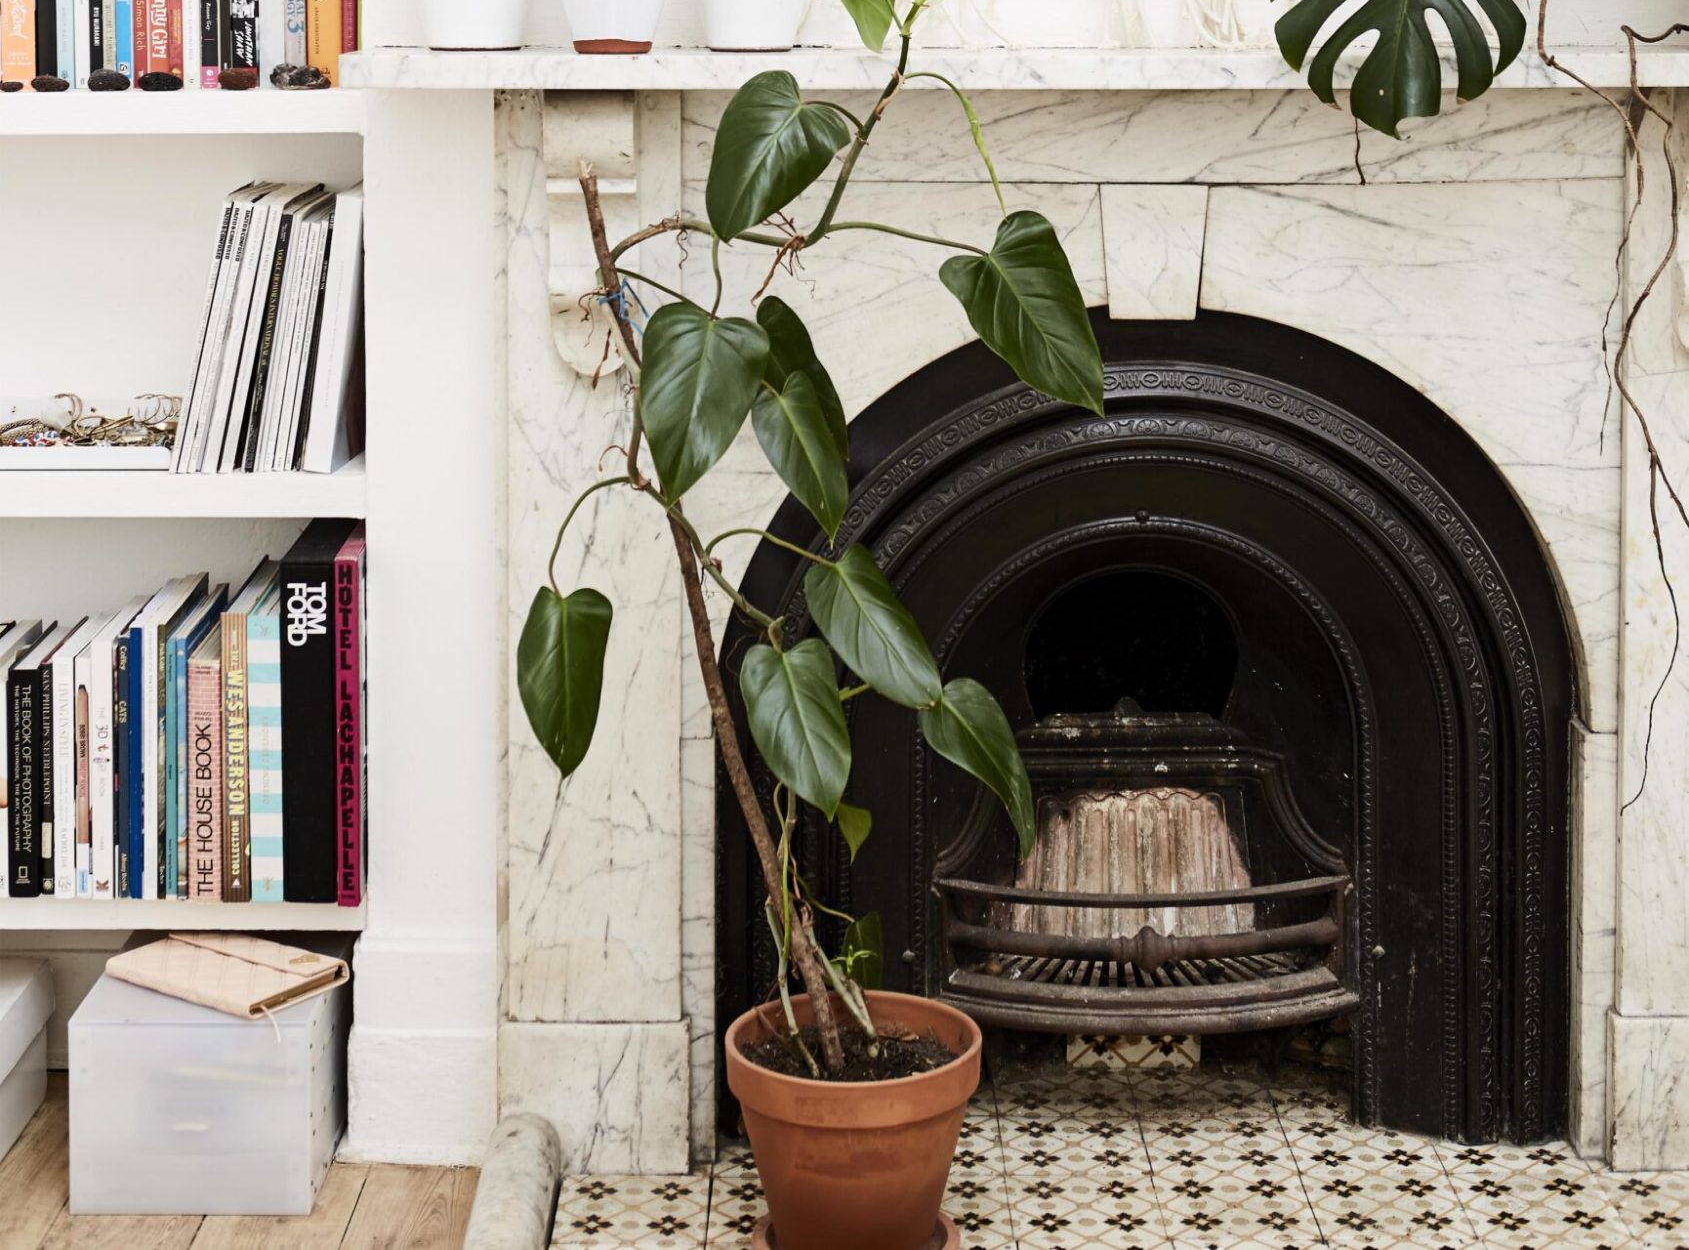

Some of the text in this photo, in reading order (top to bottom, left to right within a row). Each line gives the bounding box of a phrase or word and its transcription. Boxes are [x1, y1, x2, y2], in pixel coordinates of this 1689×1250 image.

[136, 0, 145, 51] Simon Rich
[152, 29, 168, 59] Girl
[234, 30, 245, 58] SHAW
[243, 20, 253, 67] JONATHAN
[287, 19, 305, 34] 3
[286, 582, 308, 647] FORD
[305, 581, 327, 634] TOM
[42, 669, 52, 806] SIAN PHILLIPS NEEDLEPOINT
[95, 724, 109, 739] 3D
[118, 700, 127, 723] CATS
[337, 563, 356, 893] HOTEL LACHAPELLE
[21, 684, 33, 853] THE BOOK OF PHOTOGRAPHY
[195, 723, 212, 780] BOOK
[226, 669, 245, 816] WES ANDERSON
[195, 787, 213, 852] HOUSE
[230, 820, 240, 876] COLLECTION
[196, 859, 214, 896] THE
